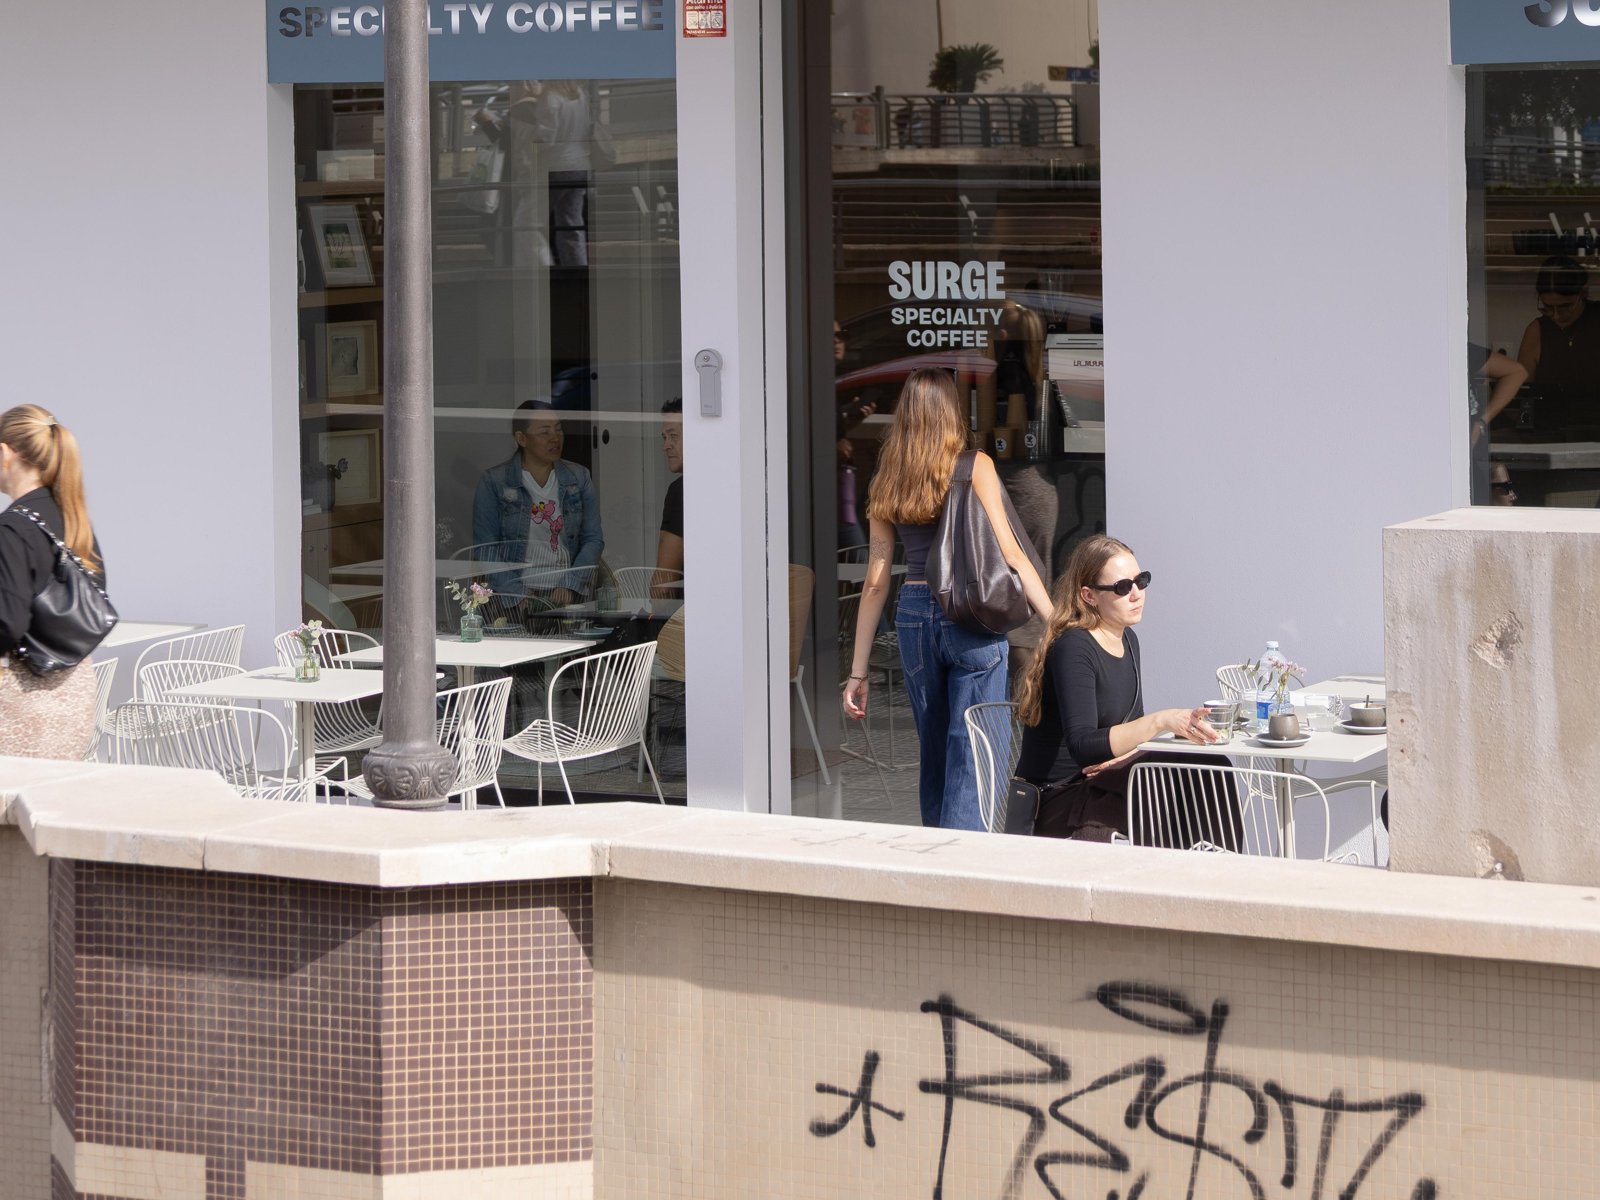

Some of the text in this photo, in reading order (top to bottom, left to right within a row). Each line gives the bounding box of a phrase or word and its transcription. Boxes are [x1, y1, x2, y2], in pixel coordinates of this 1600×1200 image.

[279, 0, 664, 38] SPECLTY COFFEE
[888, 260, 1006, 300] SURGE
[891, 308, 1004, 325] SPECIALTY
[907, 329, 989, 347] COFFEE
